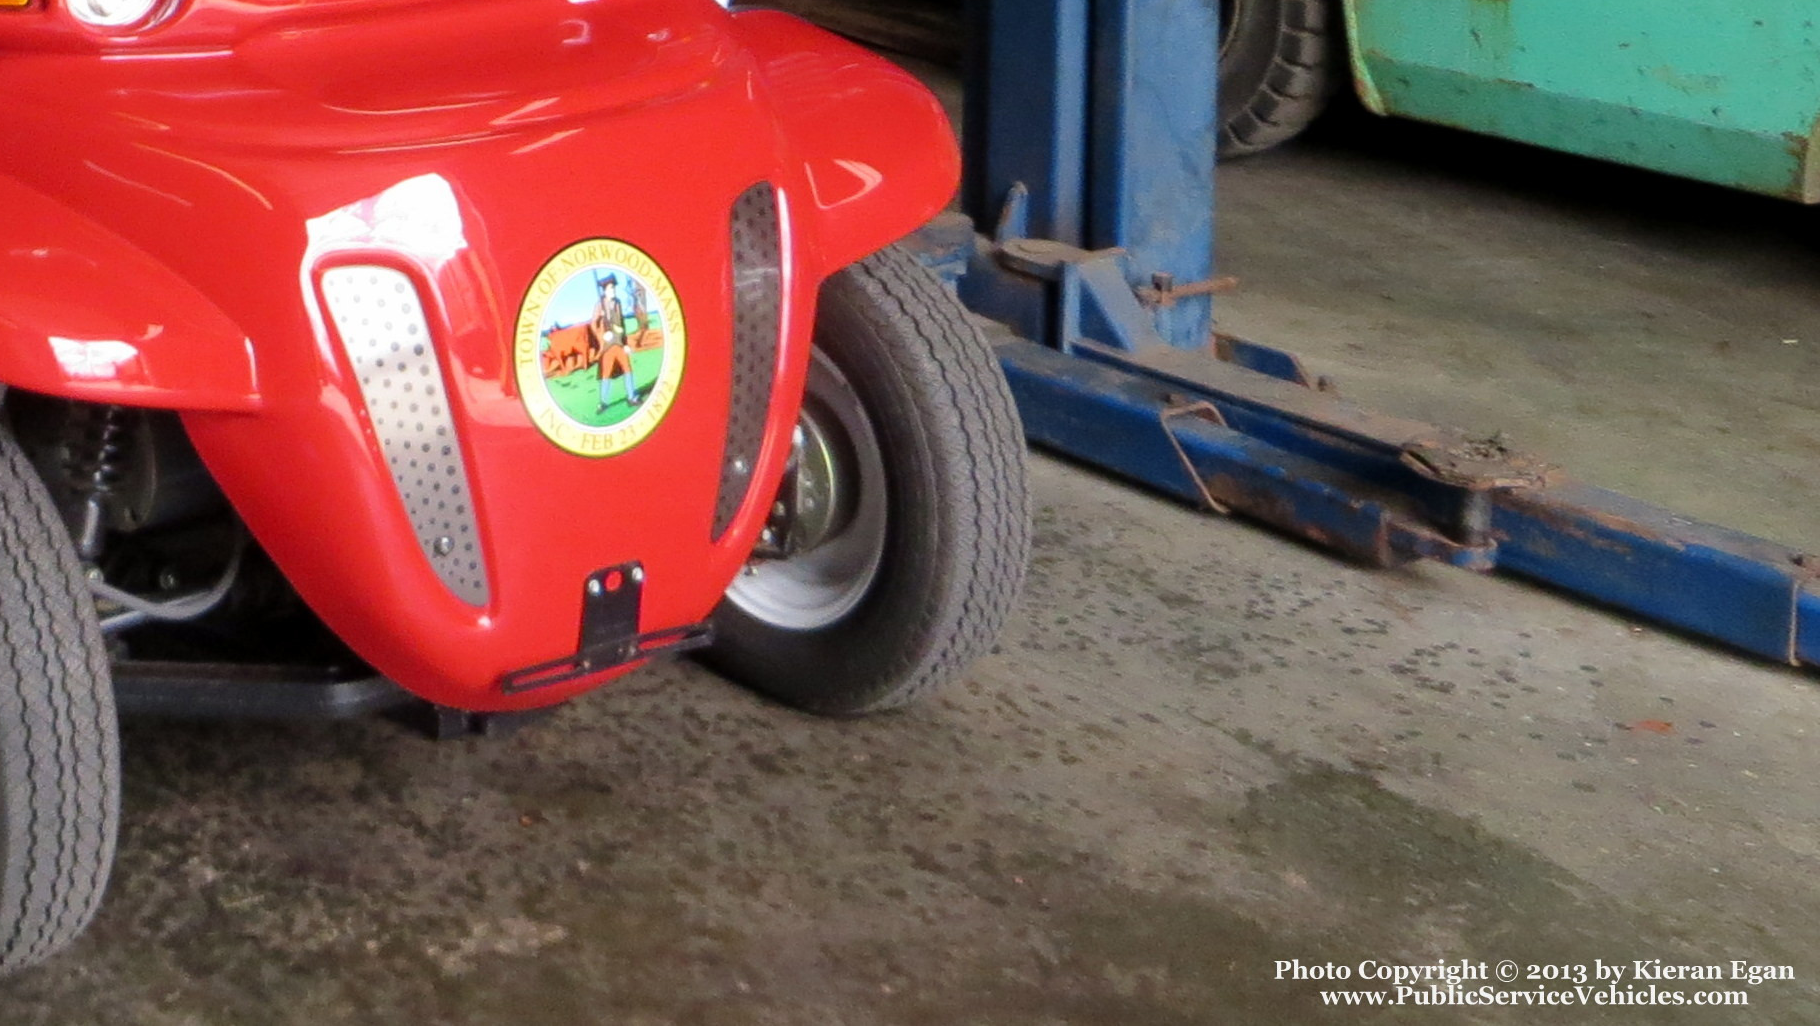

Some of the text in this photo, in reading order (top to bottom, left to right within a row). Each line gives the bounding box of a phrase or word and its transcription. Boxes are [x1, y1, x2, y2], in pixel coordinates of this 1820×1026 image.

[520, 243, 680, 366] TOWN OF NORWOOD MASS
[540, 409, 568, 440] INC
[581, 433, 614, 451] FEB
